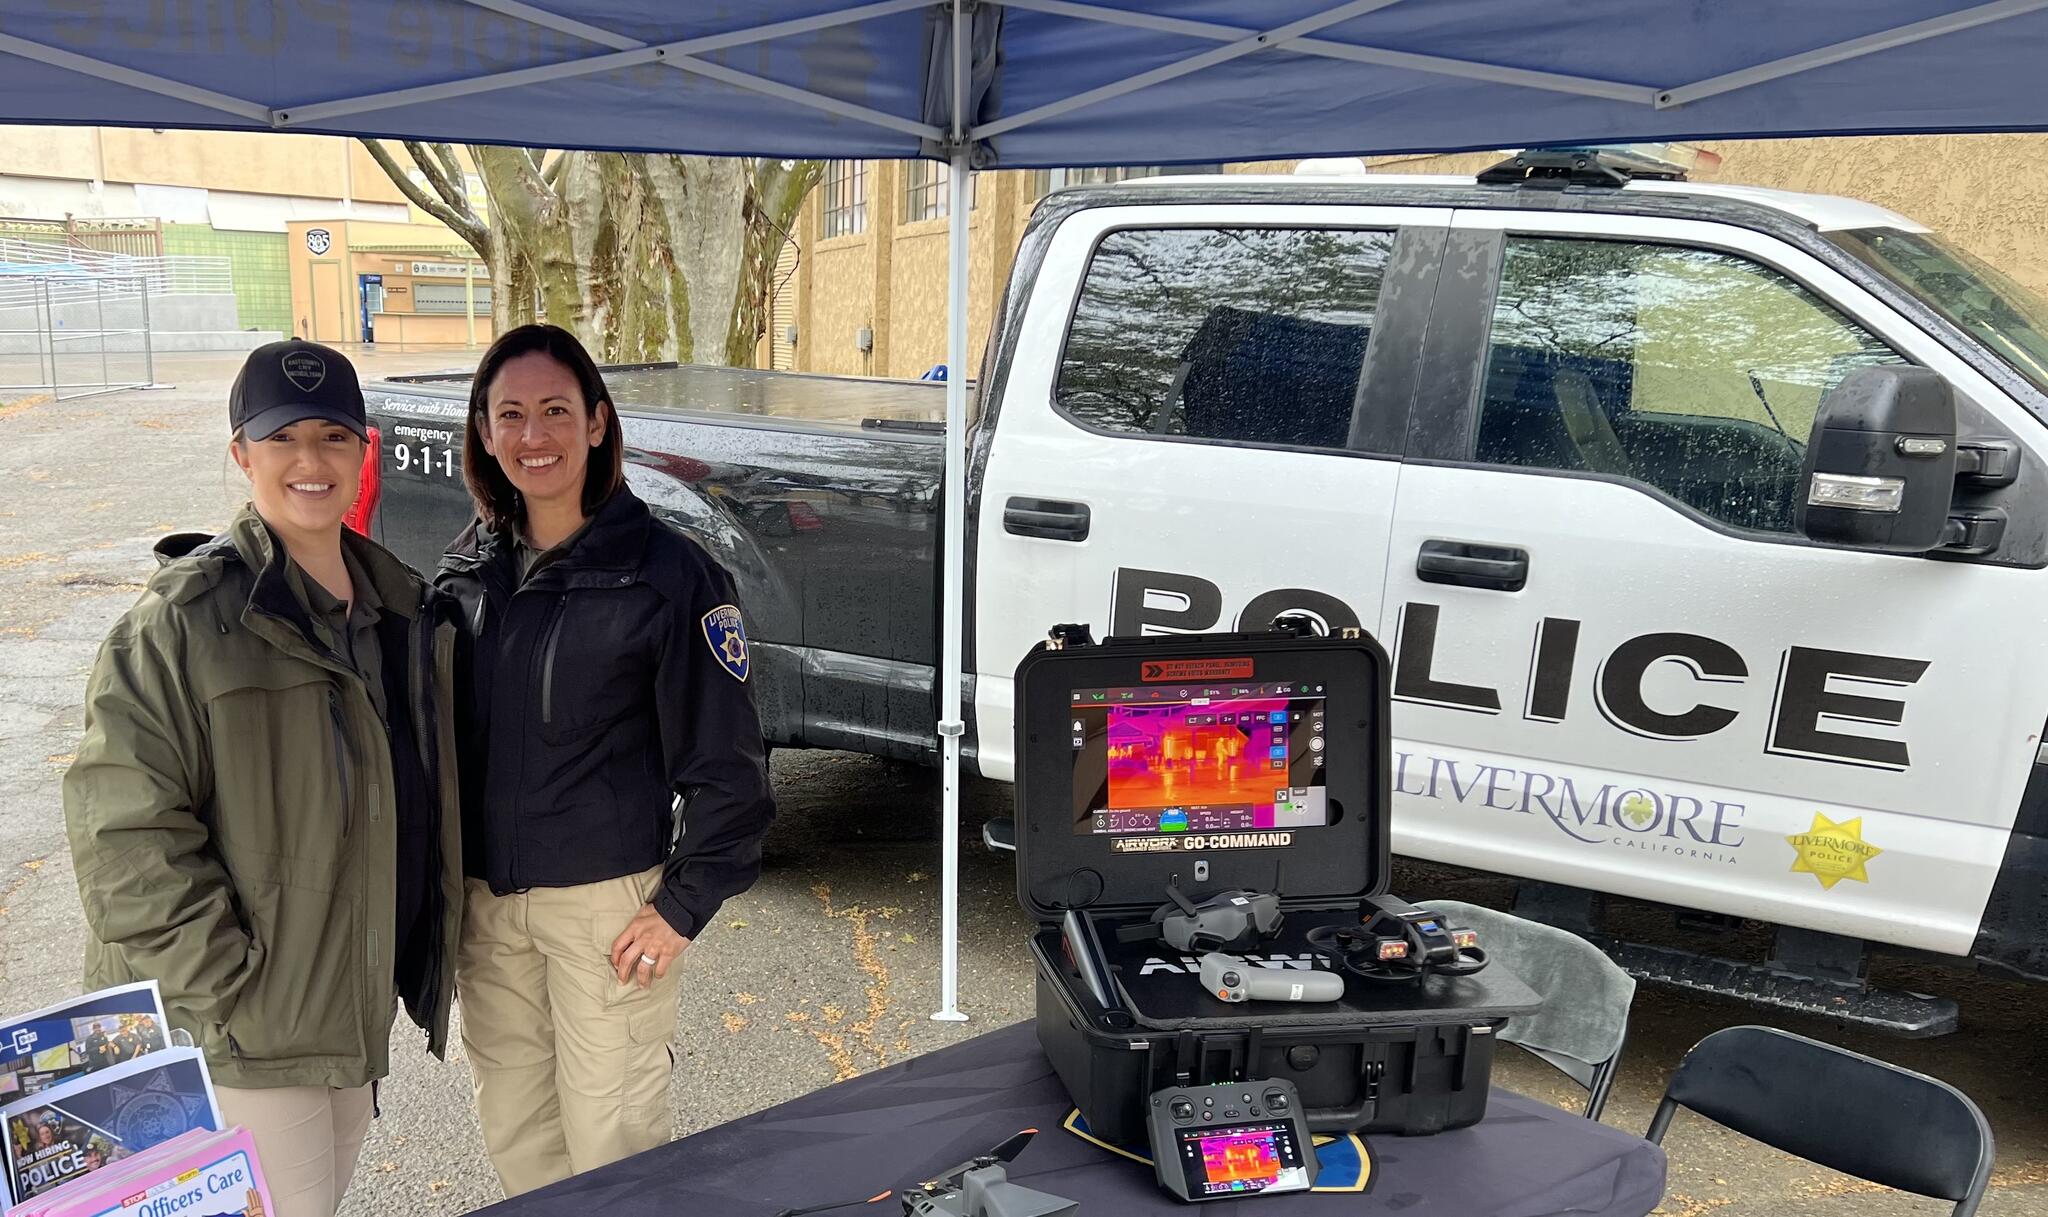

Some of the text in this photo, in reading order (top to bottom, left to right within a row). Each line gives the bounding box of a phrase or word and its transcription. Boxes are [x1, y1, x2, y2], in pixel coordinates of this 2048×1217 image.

[307, 233, 330, 245] 805
[382, 398, 469, 417] Service with Hono
[394, 425, 453, 444] emergency
[1391, 753, 1745, 848] LIVERMORE
[1116, 837, 1178, 848] AIRWORX
[1183, 832, 1291, 850] GO-COMMAND
[1613, 837, 1737, 864] CALIFORNIA
[1792, 835, 1873, 857] LIVERMORE
[1809, 850, 1853, 863] POLICE
[20, 1150, 87, 1191] POLICE
[123, 1193, 147, 1207] STOP
[139, 1187, 203, 1217] Officers
[207, 1168, 243, 1194] Care
